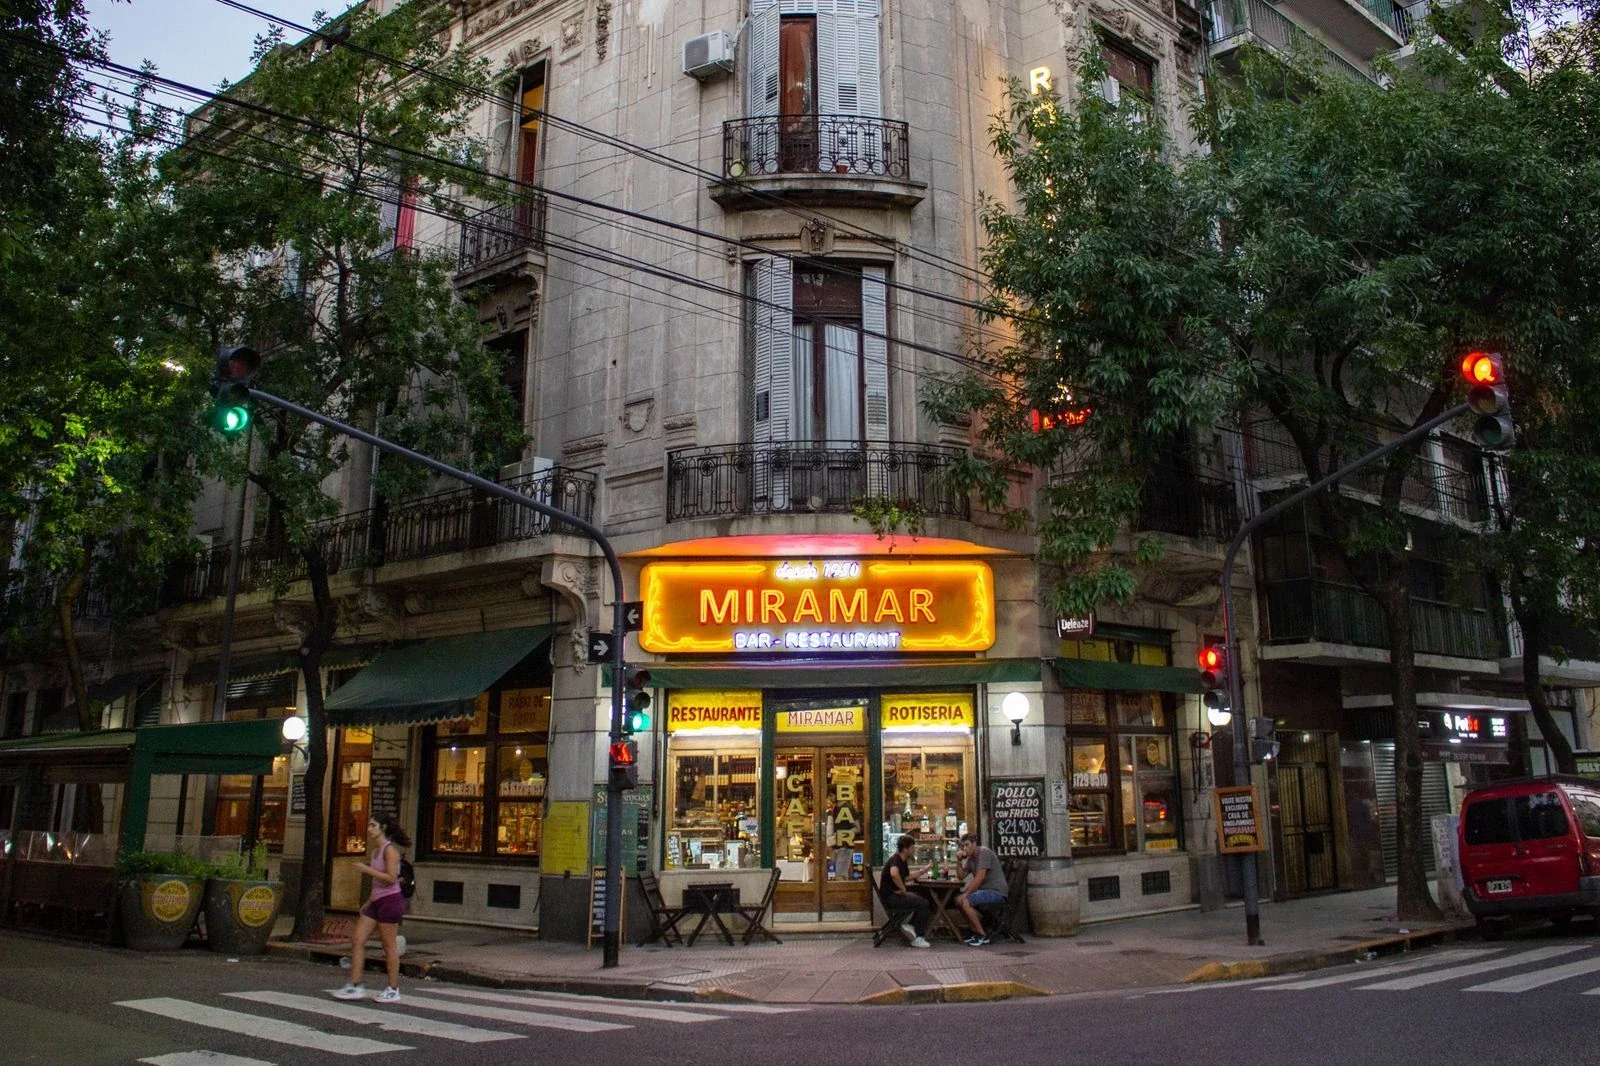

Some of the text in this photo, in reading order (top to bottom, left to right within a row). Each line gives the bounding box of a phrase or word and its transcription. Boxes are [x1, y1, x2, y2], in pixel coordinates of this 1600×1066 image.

[699, 588, 940, 627] MIRAMAR
[733, 631, 771, 649] BAR
[784, 631, 902, 649] RESTAURANT
[671, 706, 761, 722] RESTAURANTE
[788, 710, 854, 725] MIRAMAR
[889, 705, 964, 721] ROTISERIA
[996, 787, 1036, 799] POLLO
[1005, 798, 1039, 808] SPIEDO
[835, 785, 856, 847] BAR
[995, 808, 1040, 818] CON FRITAS
[1000, 836, 1035, 846] PARA
[997, 846, 1040, 857] LLEVAR
